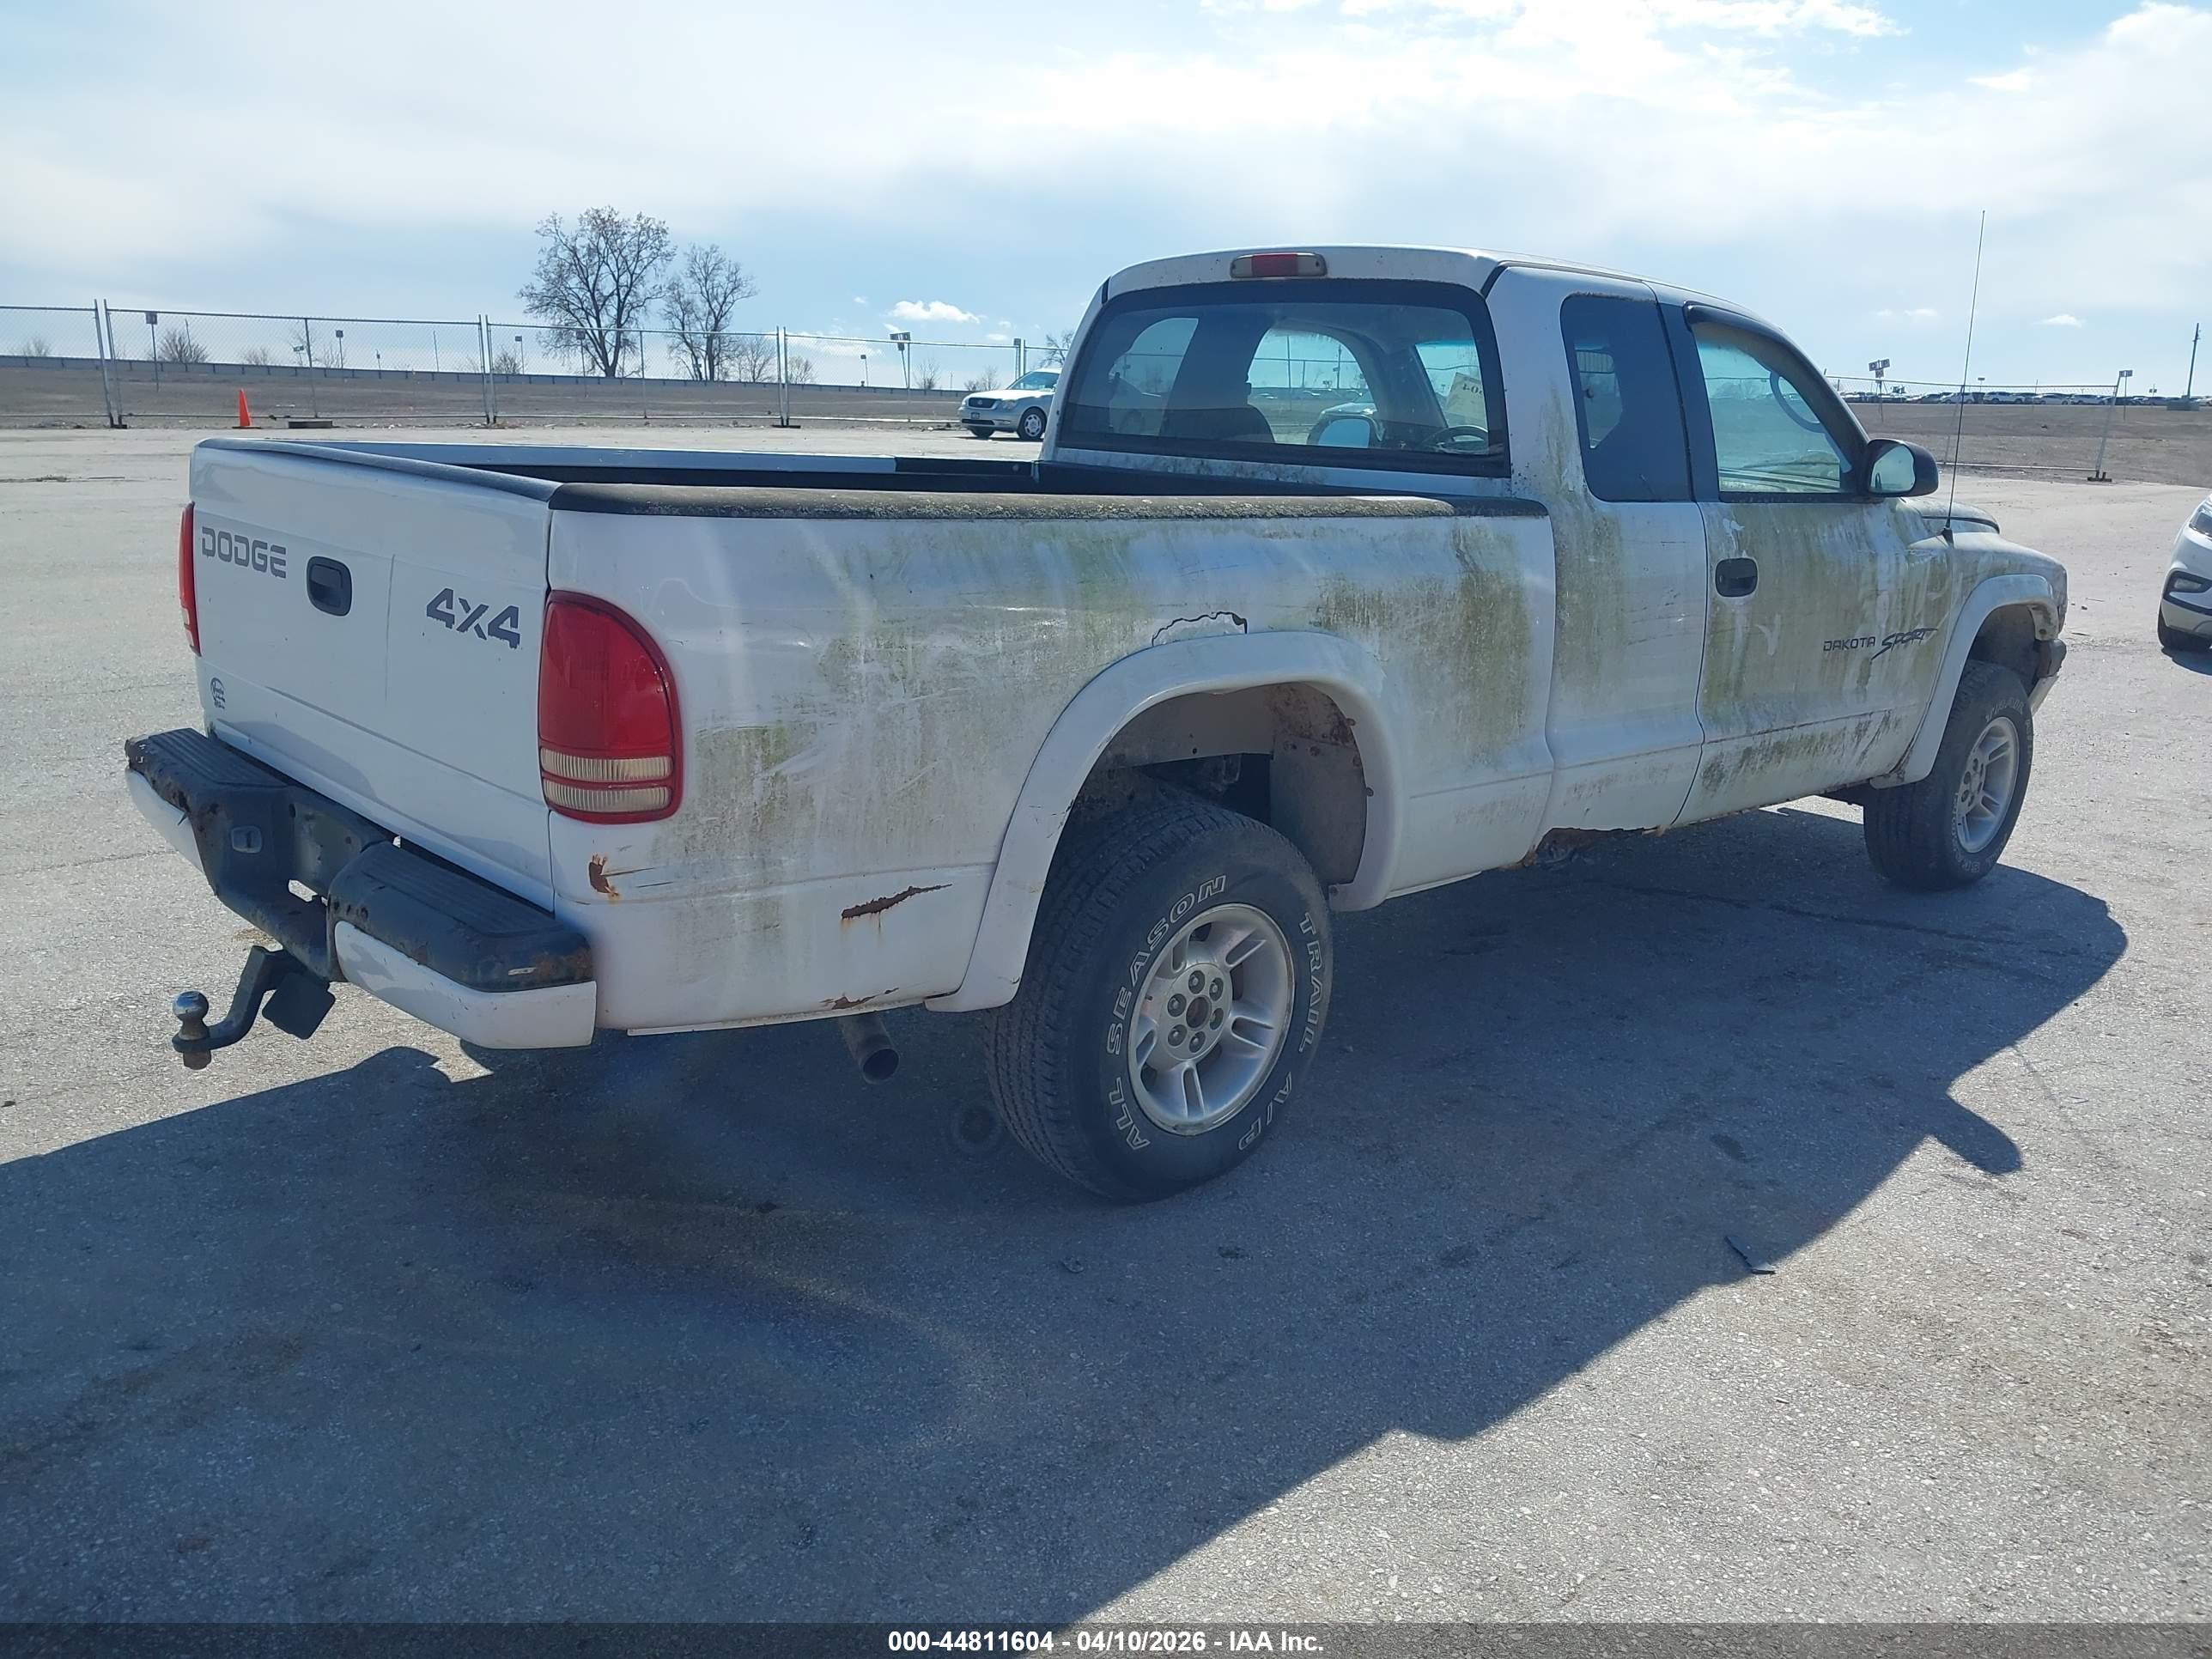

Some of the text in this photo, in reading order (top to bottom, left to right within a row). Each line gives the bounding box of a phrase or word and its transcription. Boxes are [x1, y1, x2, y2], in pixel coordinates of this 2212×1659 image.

[202, 526, 287, 579] DODGE
[1823, 628, 1938, 661] DAKOTA SPORT
[1107, 874, 1227, 1151] ALL SEASON
[1238, 912, 1324, 1151] TRAIL A/P
